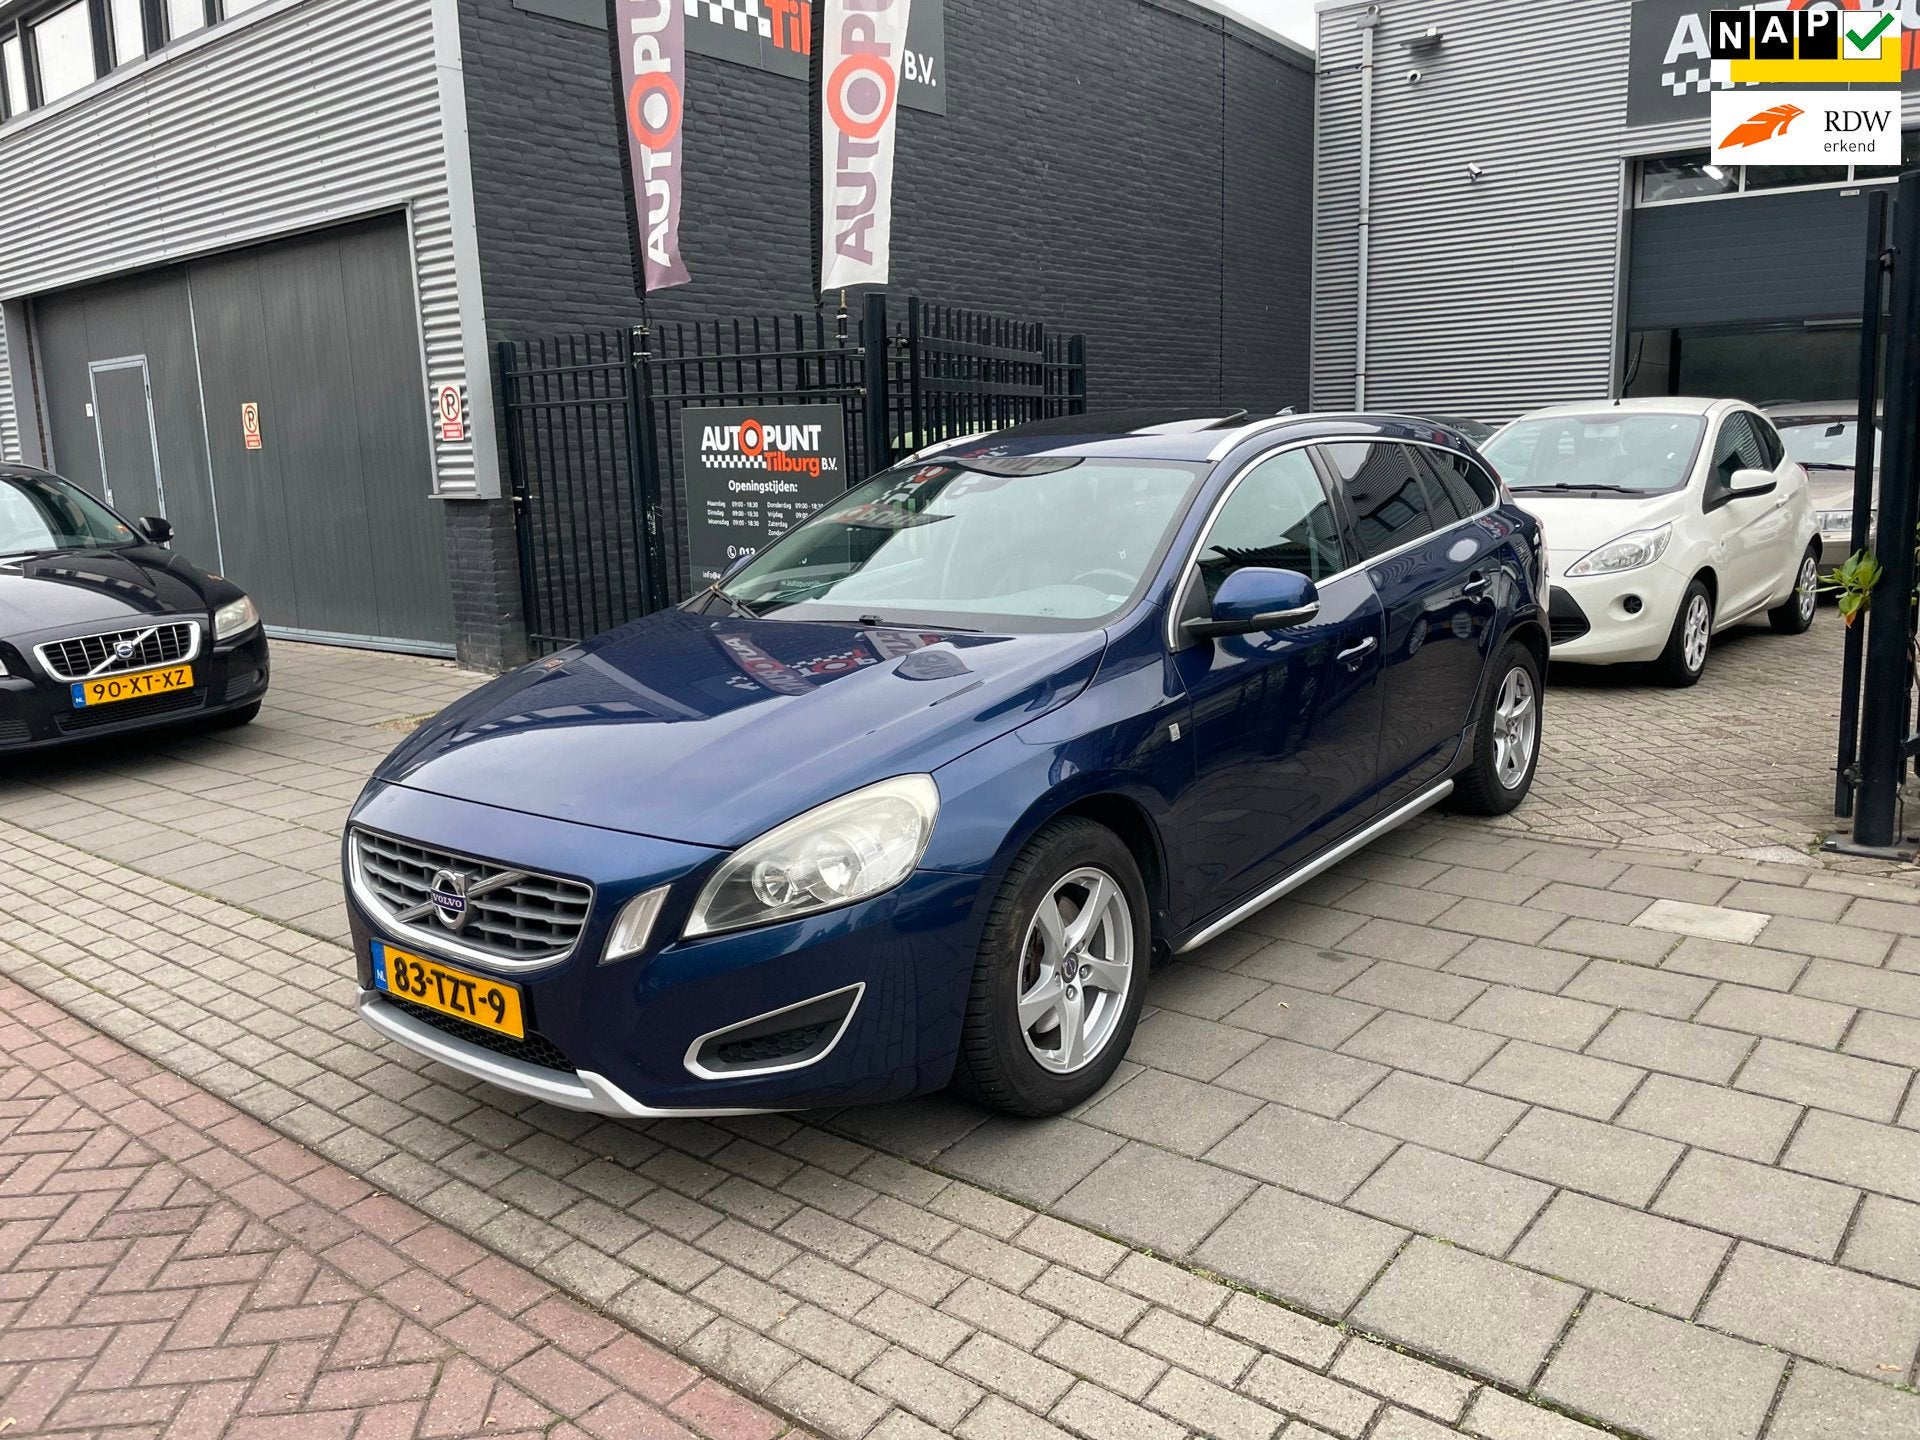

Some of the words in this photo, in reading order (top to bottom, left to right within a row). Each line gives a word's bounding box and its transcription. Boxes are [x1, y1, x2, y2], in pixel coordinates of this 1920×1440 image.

[904, 50, 937, 87] B.V.
[701, 418, 821, 457] AUTOPUNT
[763, 451, 819, 477] Tilburg
[821, 457, 838, 470] B.V.
[728, 480, 798, 494] Openingstijden:
[92, 669, 186, 701] 90-XT-XZ
[432, 893, 463, 908] VOLVO
[376, 969, 387, 982] NL
[393, 956, 506, 1025] 83-TZT-9
